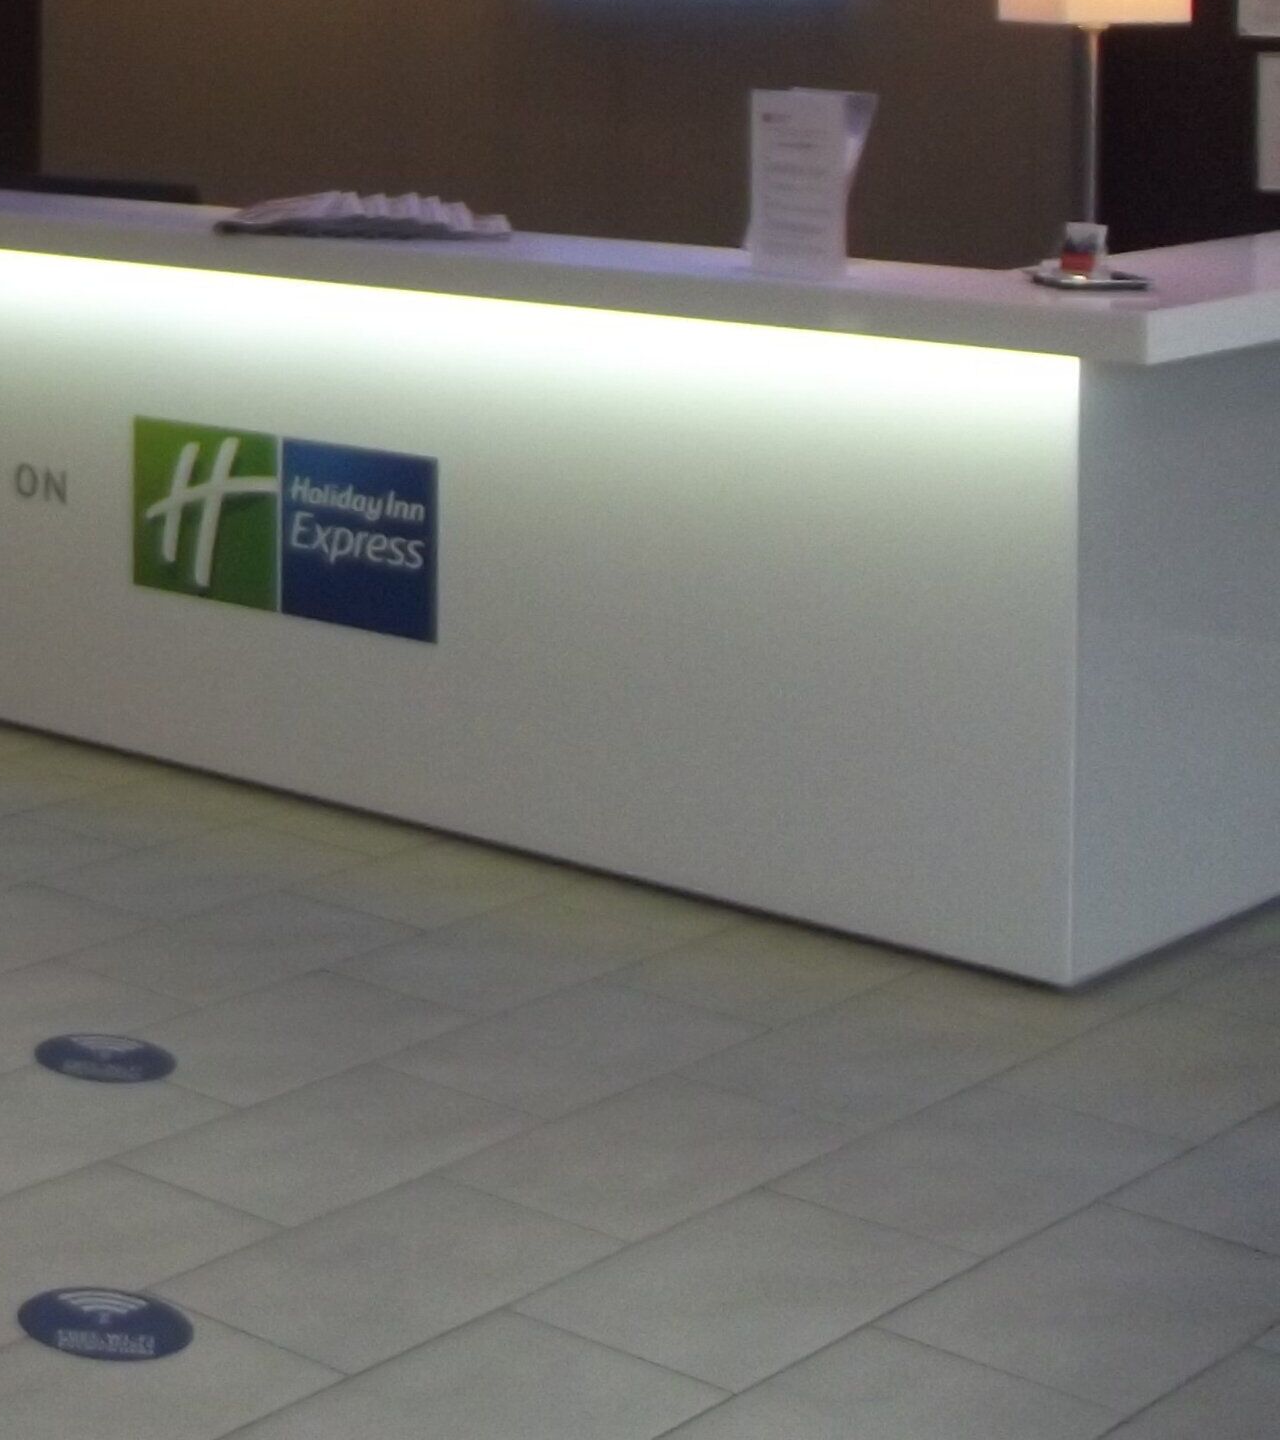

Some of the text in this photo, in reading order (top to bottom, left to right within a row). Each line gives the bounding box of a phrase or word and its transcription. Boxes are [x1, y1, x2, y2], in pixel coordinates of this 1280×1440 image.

[14, 462, 68, 505] ON
[290, 474, 426, 523] Holiday Inn
[290, 510, 426, 570] Express
